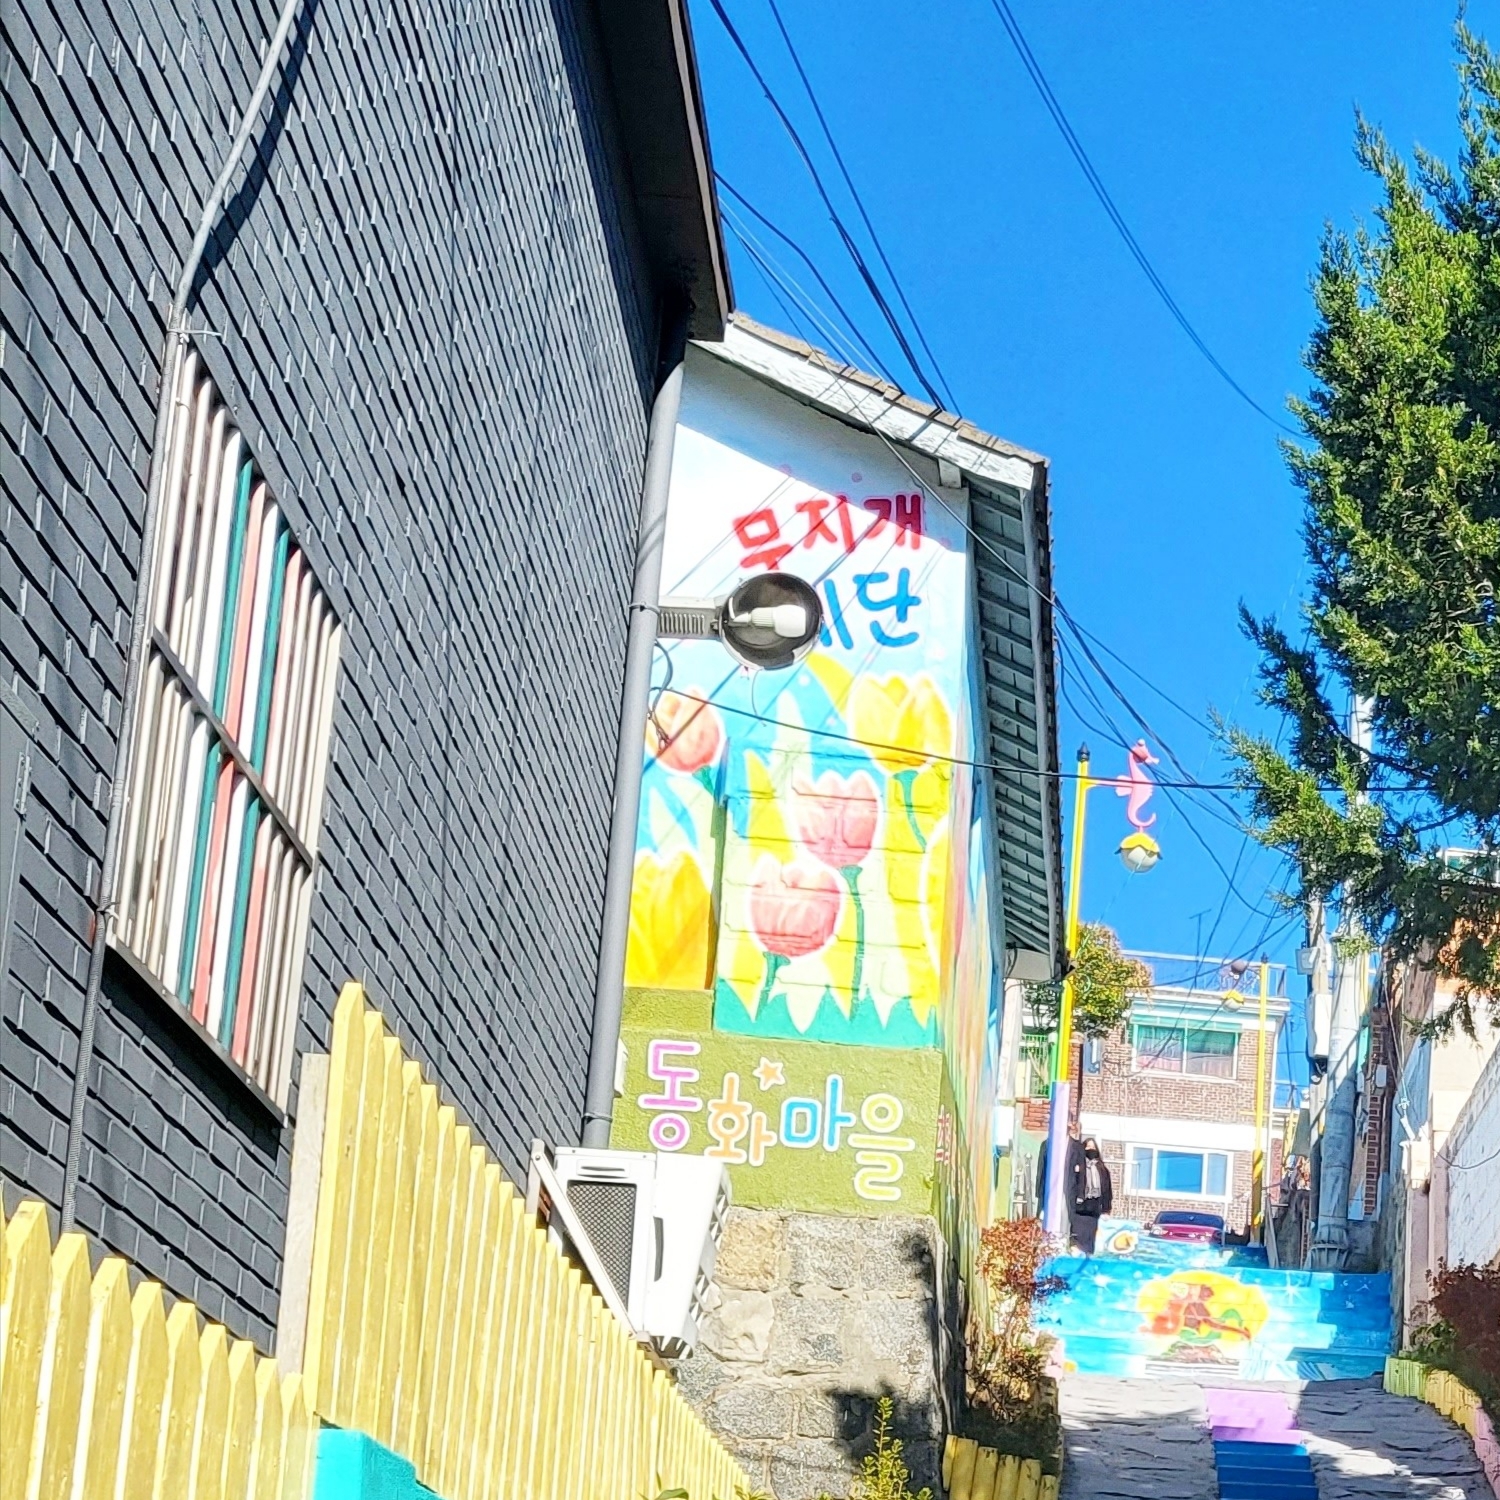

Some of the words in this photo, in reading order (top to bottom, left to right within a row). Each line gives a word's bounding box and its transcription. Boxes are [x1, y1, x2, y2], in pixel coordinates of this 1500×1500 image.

[731, 493, 922, 569] 무지개
[817, 566, 922, 650] 단
[637, 1038, 916, 1202] 동화마을
